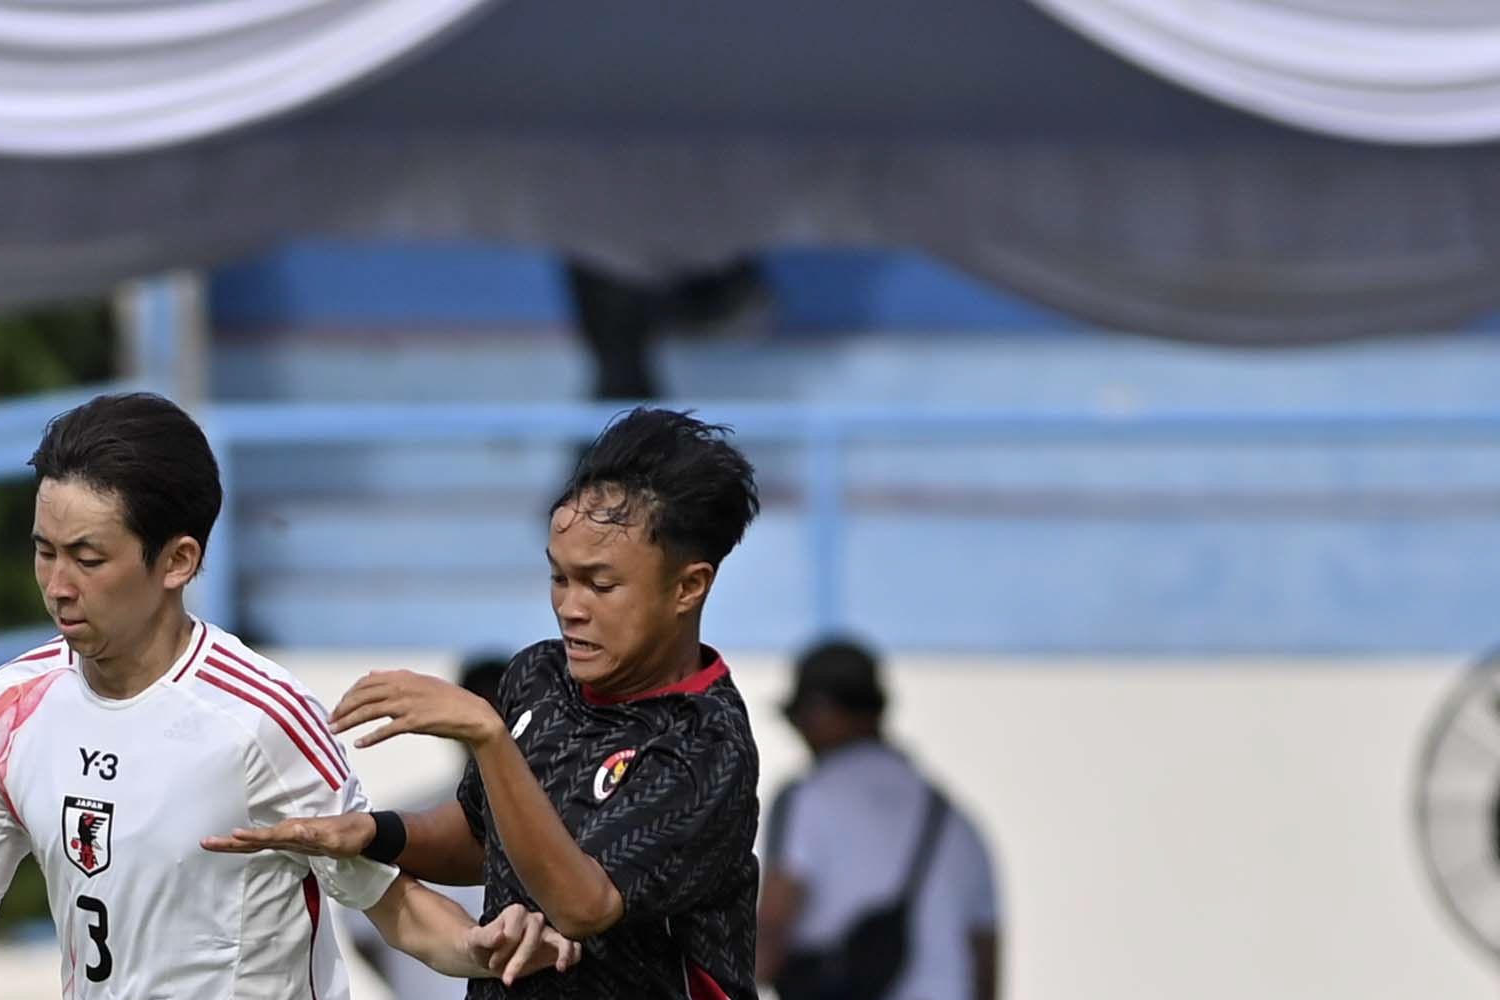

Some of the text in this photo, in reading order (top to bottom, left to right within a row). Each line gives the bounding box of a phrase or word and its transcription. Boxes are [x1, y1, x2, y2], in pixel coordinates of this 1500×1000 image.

[79, 746, 119, 781] Y-3
[75, 799, 103, 810] JAPAN
[76, 894, 113, 983] 3
